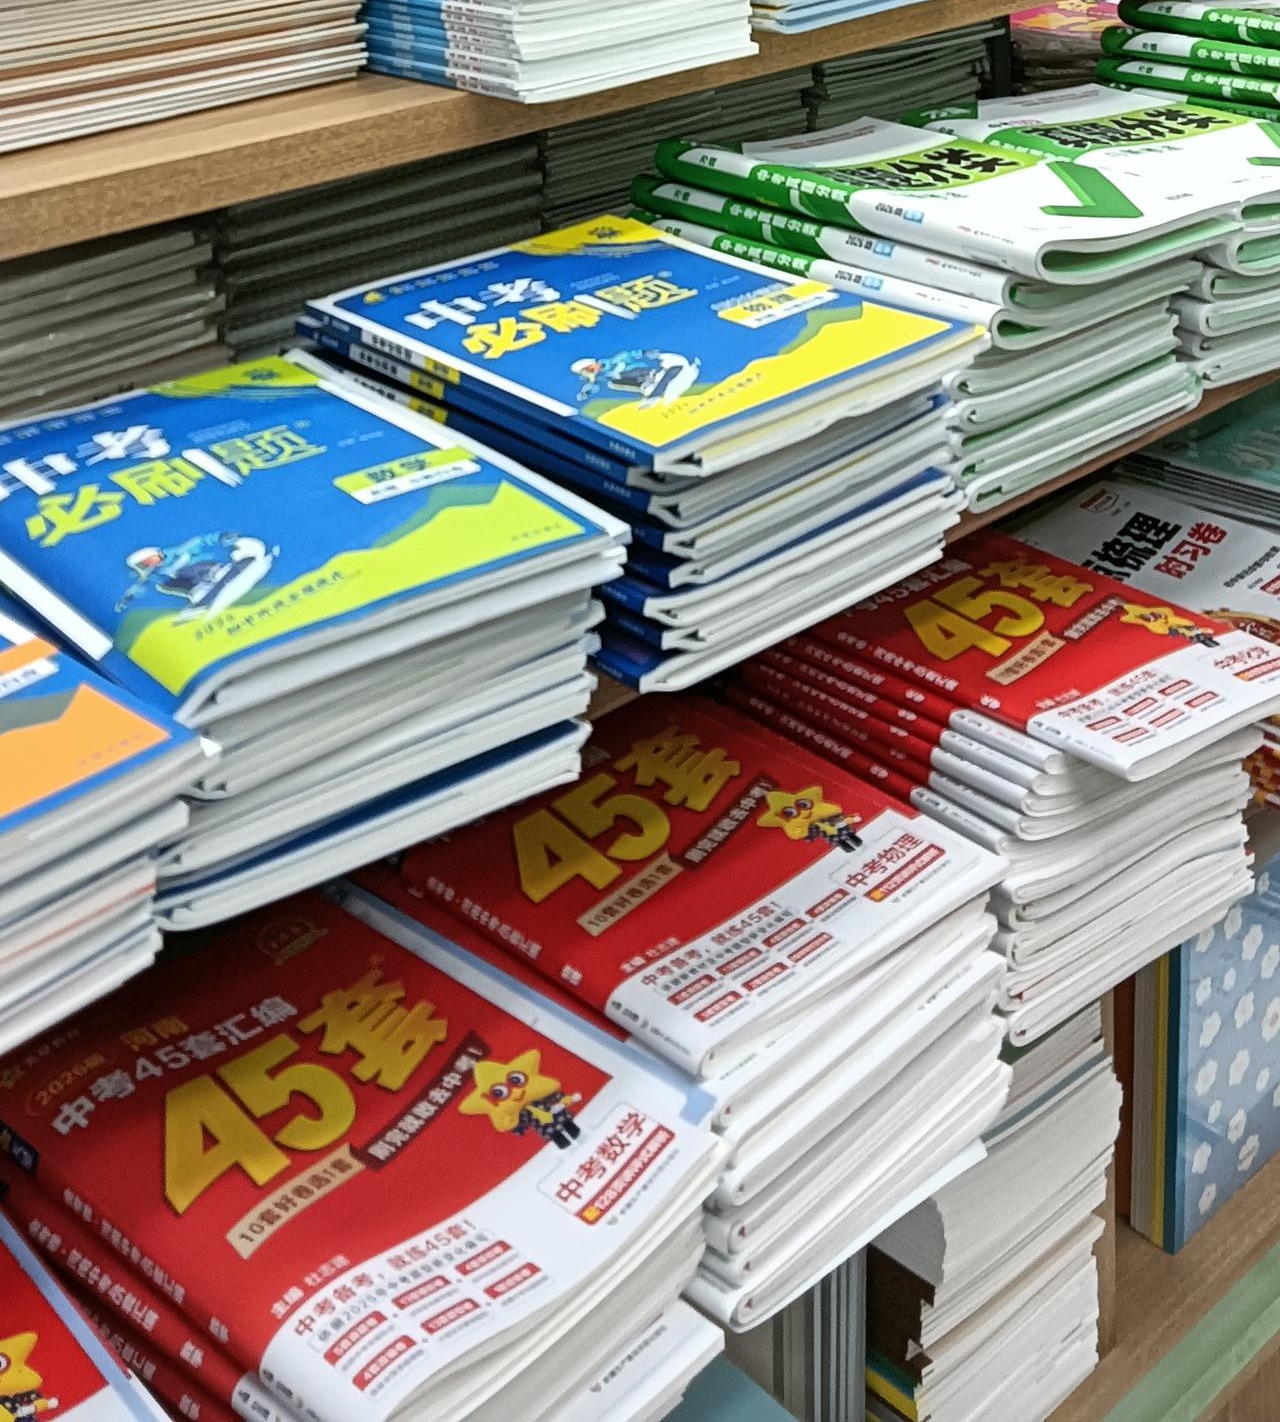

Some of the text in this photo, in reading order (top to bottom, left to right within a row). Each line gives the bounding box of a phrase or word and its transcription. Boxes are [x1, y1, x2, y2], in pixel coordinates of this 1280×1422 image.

[404, 277, 561, 330] 中考
[0, 424, 171, 502] 中考
[903, 556, 1094, 661] 45套
[512, 727, 741, 905] 45套
[844, 832, 923, 888] 中考物理
[50, 994, 298, 1136] 中考45套汇编
[164, 970, 449, 1218] 45套
[555, 1110, 646, 1203] 中考数学
